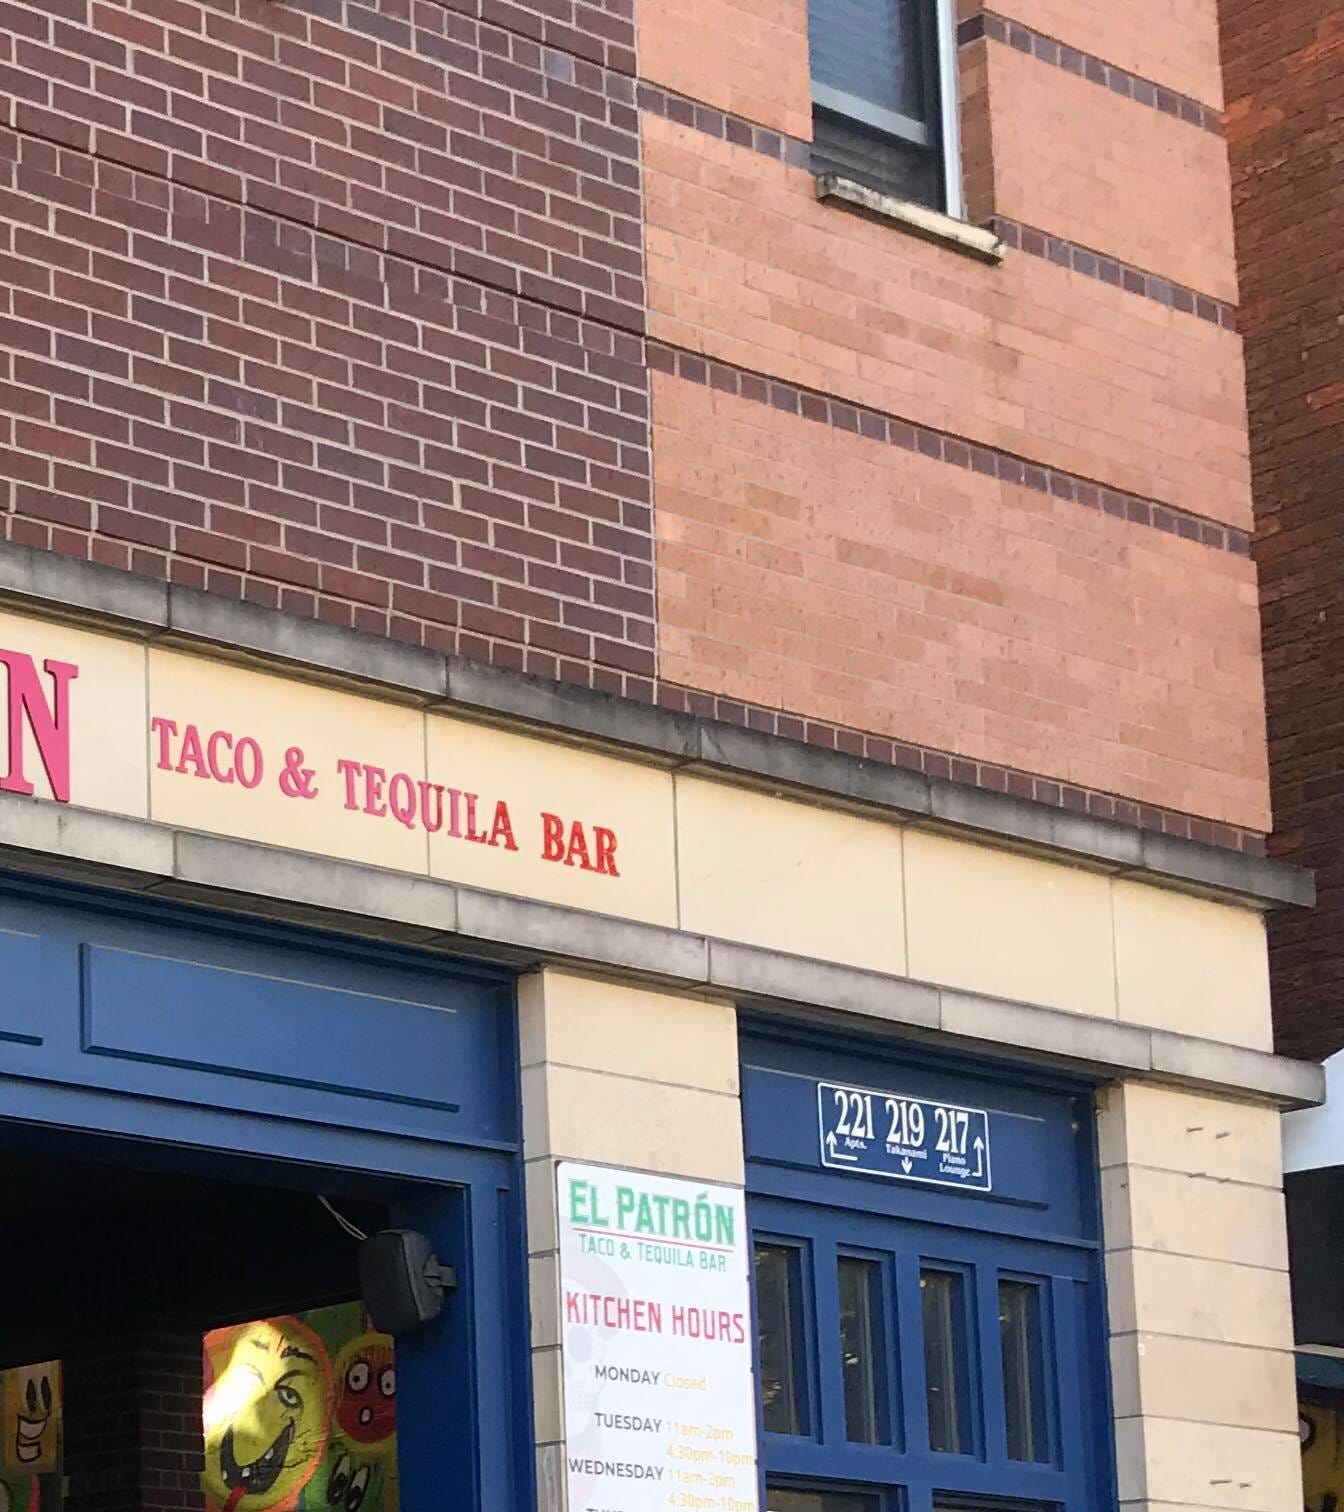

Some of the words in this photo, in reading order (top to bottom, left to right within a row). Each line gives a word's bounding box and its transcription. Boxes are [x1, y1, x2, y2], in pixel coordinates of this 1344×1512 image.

[151, 717, 265, 789] TACO
[278, 746, 319, 800] &
[337, 759, 519, 852] TEQUILA
[540, 812, 621, 877] BAR
[834, 1090, 876, 1140] 221
[885, 1100, 925, 1148] 219
[934, 1108, 969, 1155] 217
[568, 1178, 610, 1228] EL
[615, 1184, 736, 1247] PATRÓN
[579, 1234, 615, 1257] TACO
[620, 1243, 632, 1259] &
[637, 1242, 695, 1268] TEQUILA
[699, 1250, 727, 1272] BAR
[565, 1292, 662, 1334] KITCHEN
[672, 1304, 746, 1344] HOURS
[594, 1365, 661, 1385] MONDAY
[594, 1412, 663, 1434] TUESDAY
[568, 1458, 664, 1481] WEDNESDAY
